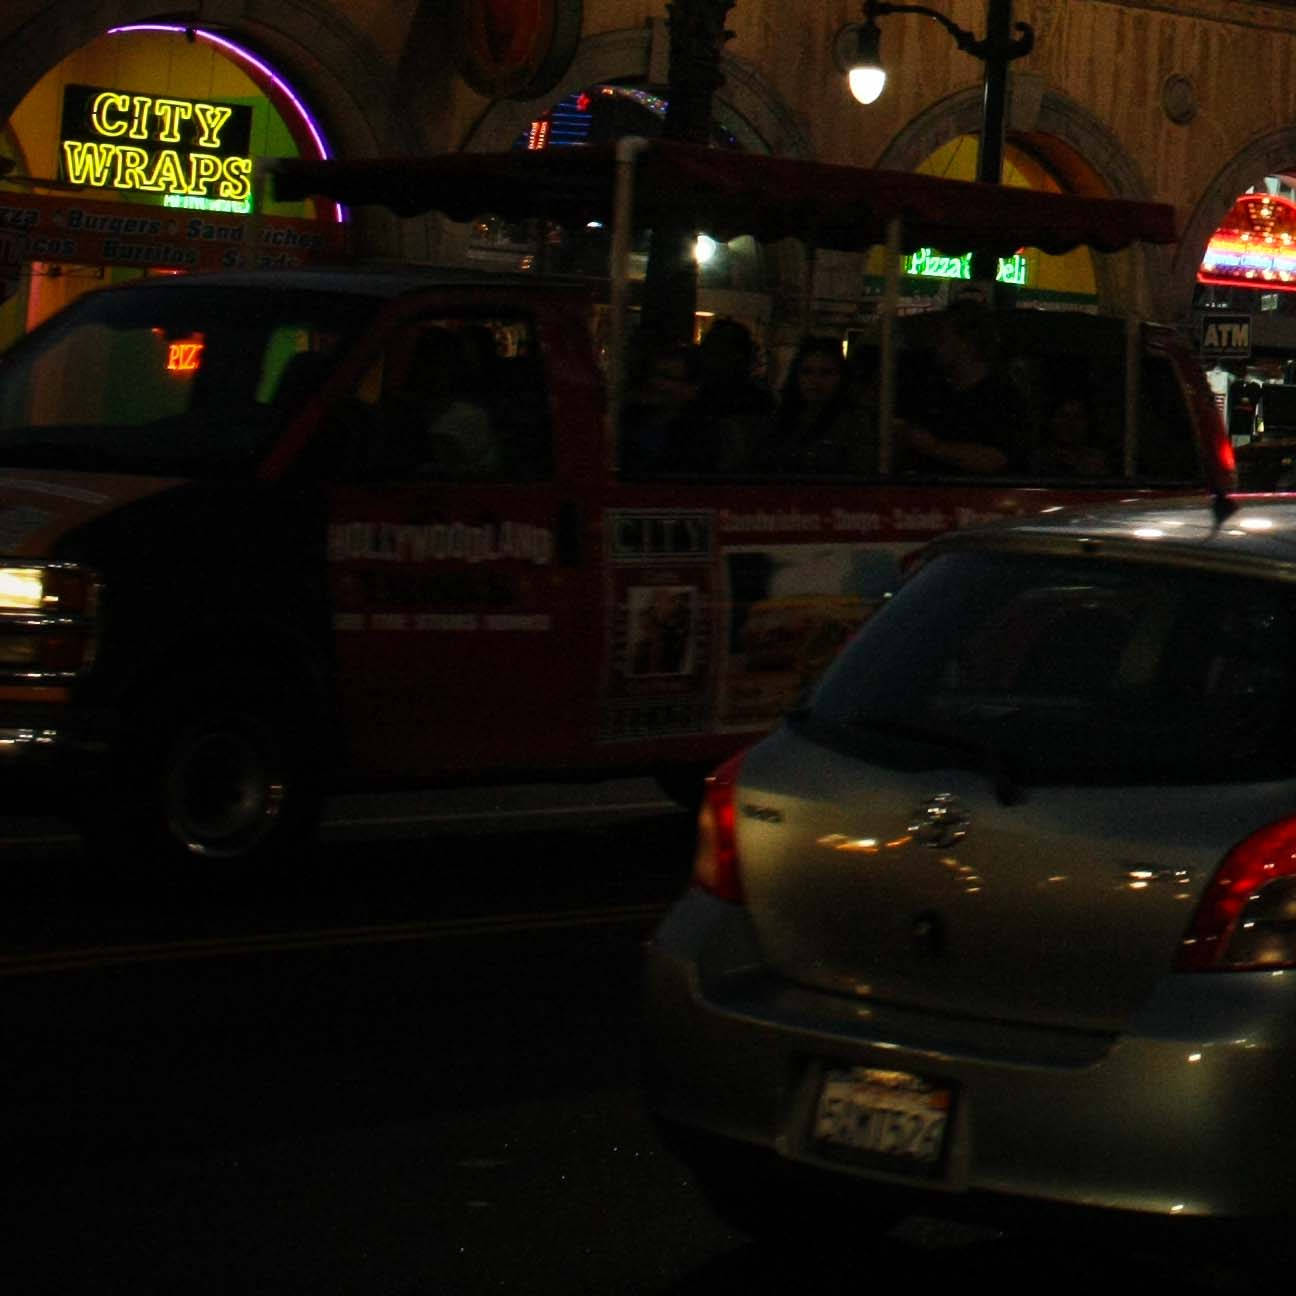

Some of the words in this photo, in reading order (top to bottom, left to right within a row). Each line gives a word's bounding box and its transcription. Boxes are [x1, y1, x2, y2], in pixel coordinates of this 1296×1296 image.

[91, 92, 232, 148] CITY
[64, 140, 253, 200] WRAPS
[1204, 324, 1249, 347] ATM
